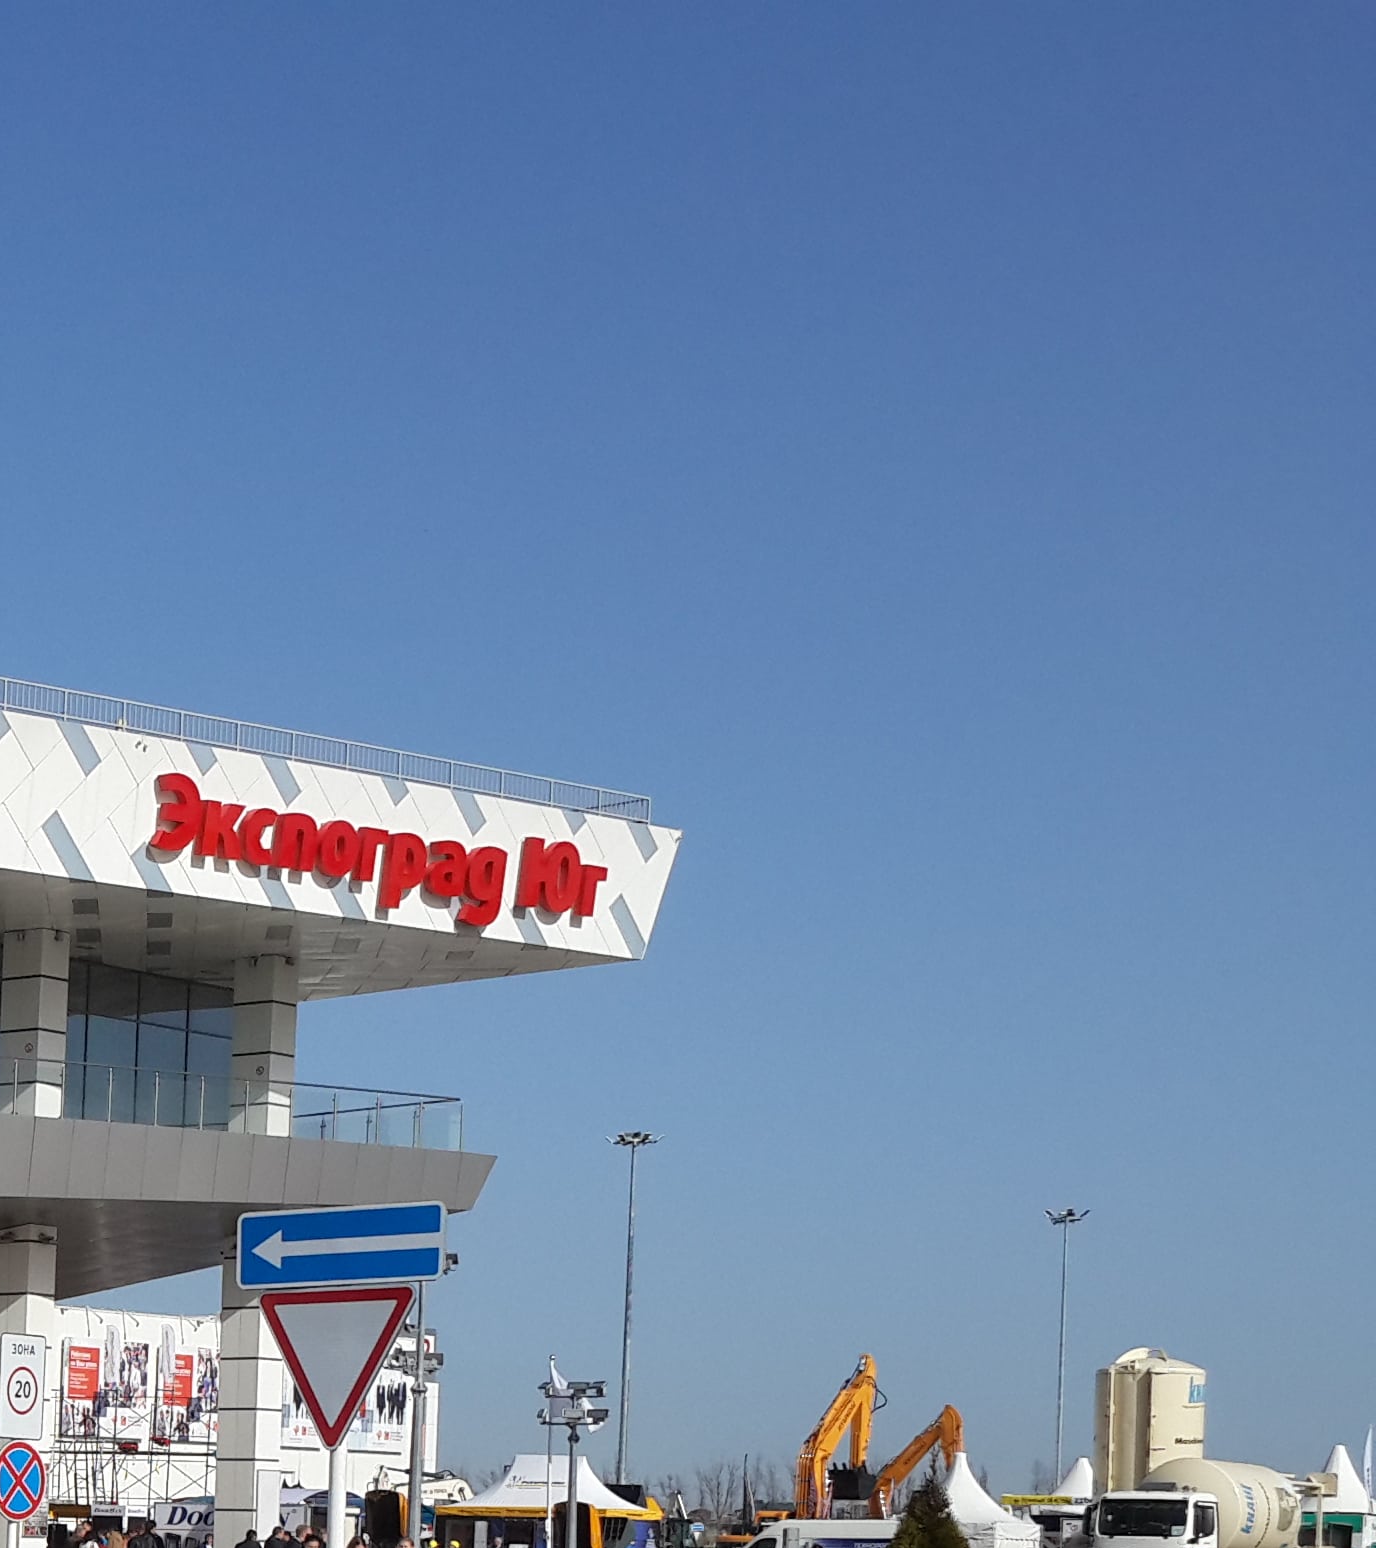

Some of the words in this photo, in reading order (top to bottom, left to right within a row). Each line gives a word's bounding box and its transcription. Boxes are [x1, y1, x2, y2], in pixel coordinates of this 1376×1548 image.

[149, 772, 508, 927] Экспоград
[515, 836, 608, 918] Юг
[11, 1343, 36, 1356] ЗОНА
[14, 1380, 31, 1398] 20
